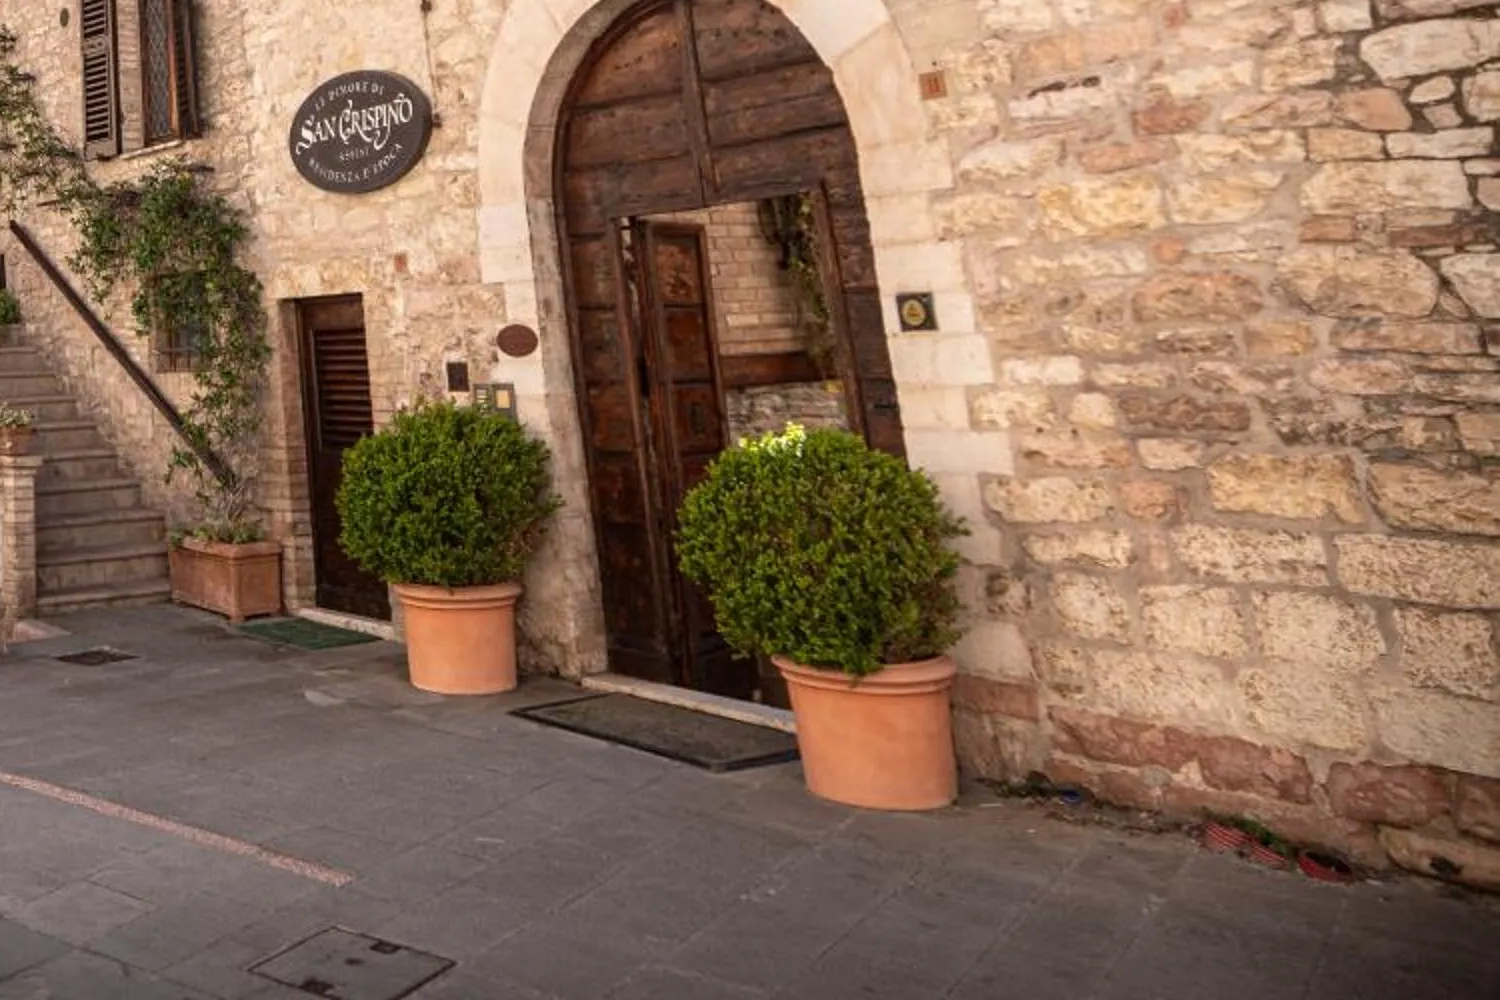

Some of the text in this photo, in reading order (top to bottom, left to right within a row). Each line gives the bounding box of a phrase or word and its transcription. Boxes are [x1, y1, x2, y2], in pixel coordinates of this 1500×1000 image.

[328, 81, 369, 102] DIMORE
[371, 81, 385, 96] DI
[296, 92, 413, 155] SAN CRISPINO
